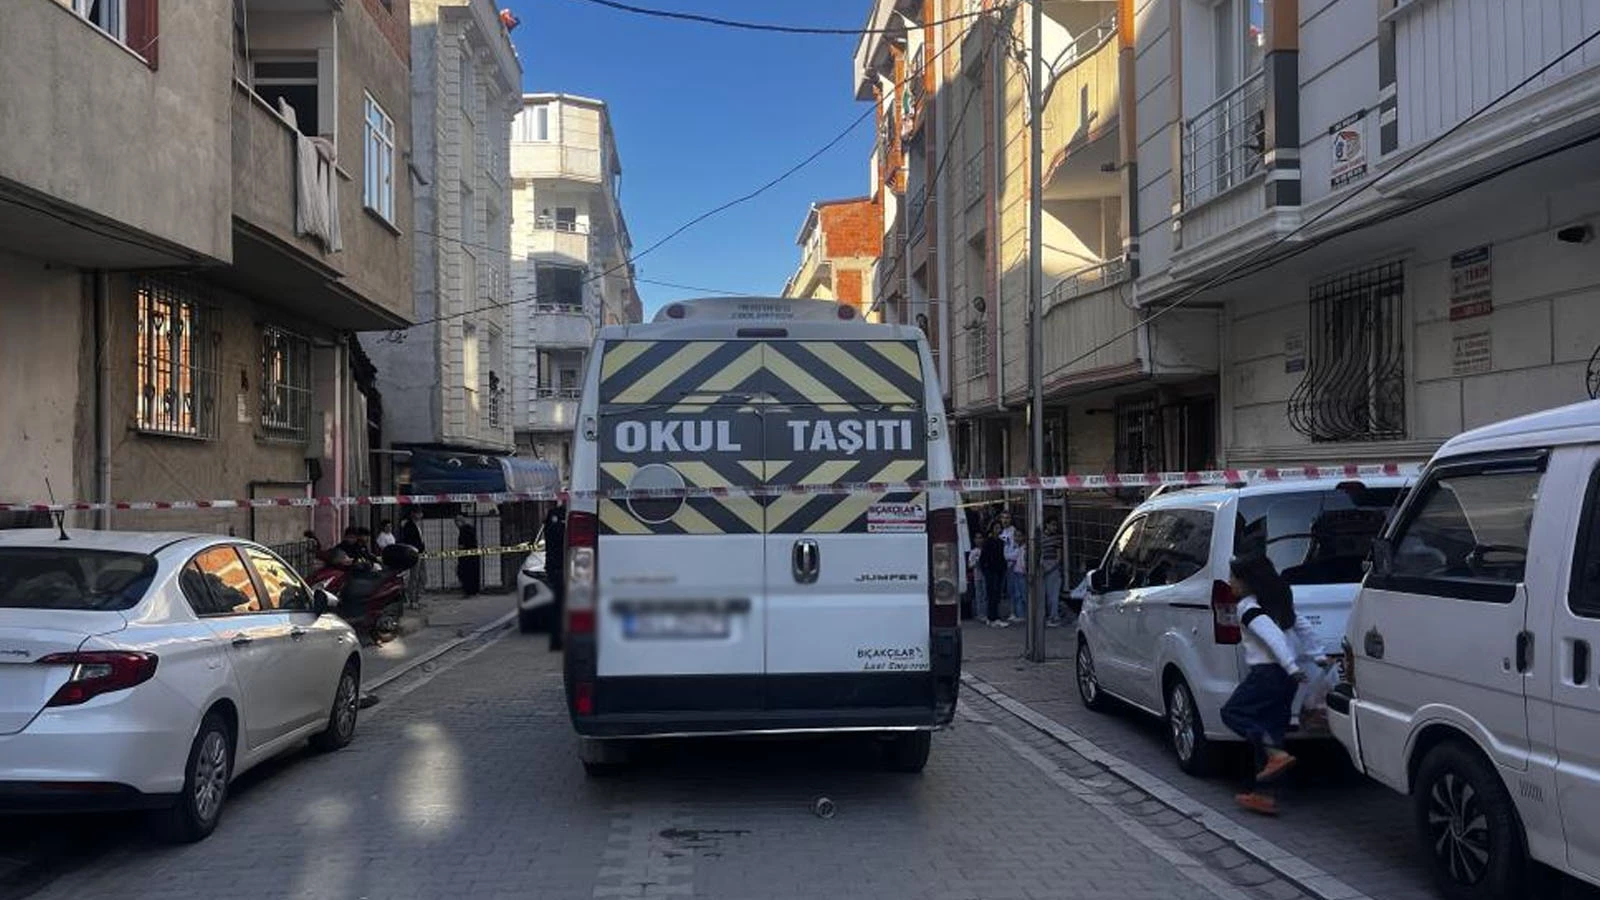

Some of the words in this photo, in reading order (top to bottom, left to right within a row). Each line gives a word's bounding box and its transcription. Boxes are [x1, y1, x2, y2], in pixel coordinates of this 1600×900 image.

[615, 420, 742, 453] OKUL
[787, 420, 912, 455] TAŞITI
[855, 574, 918, 582] JUMPER
